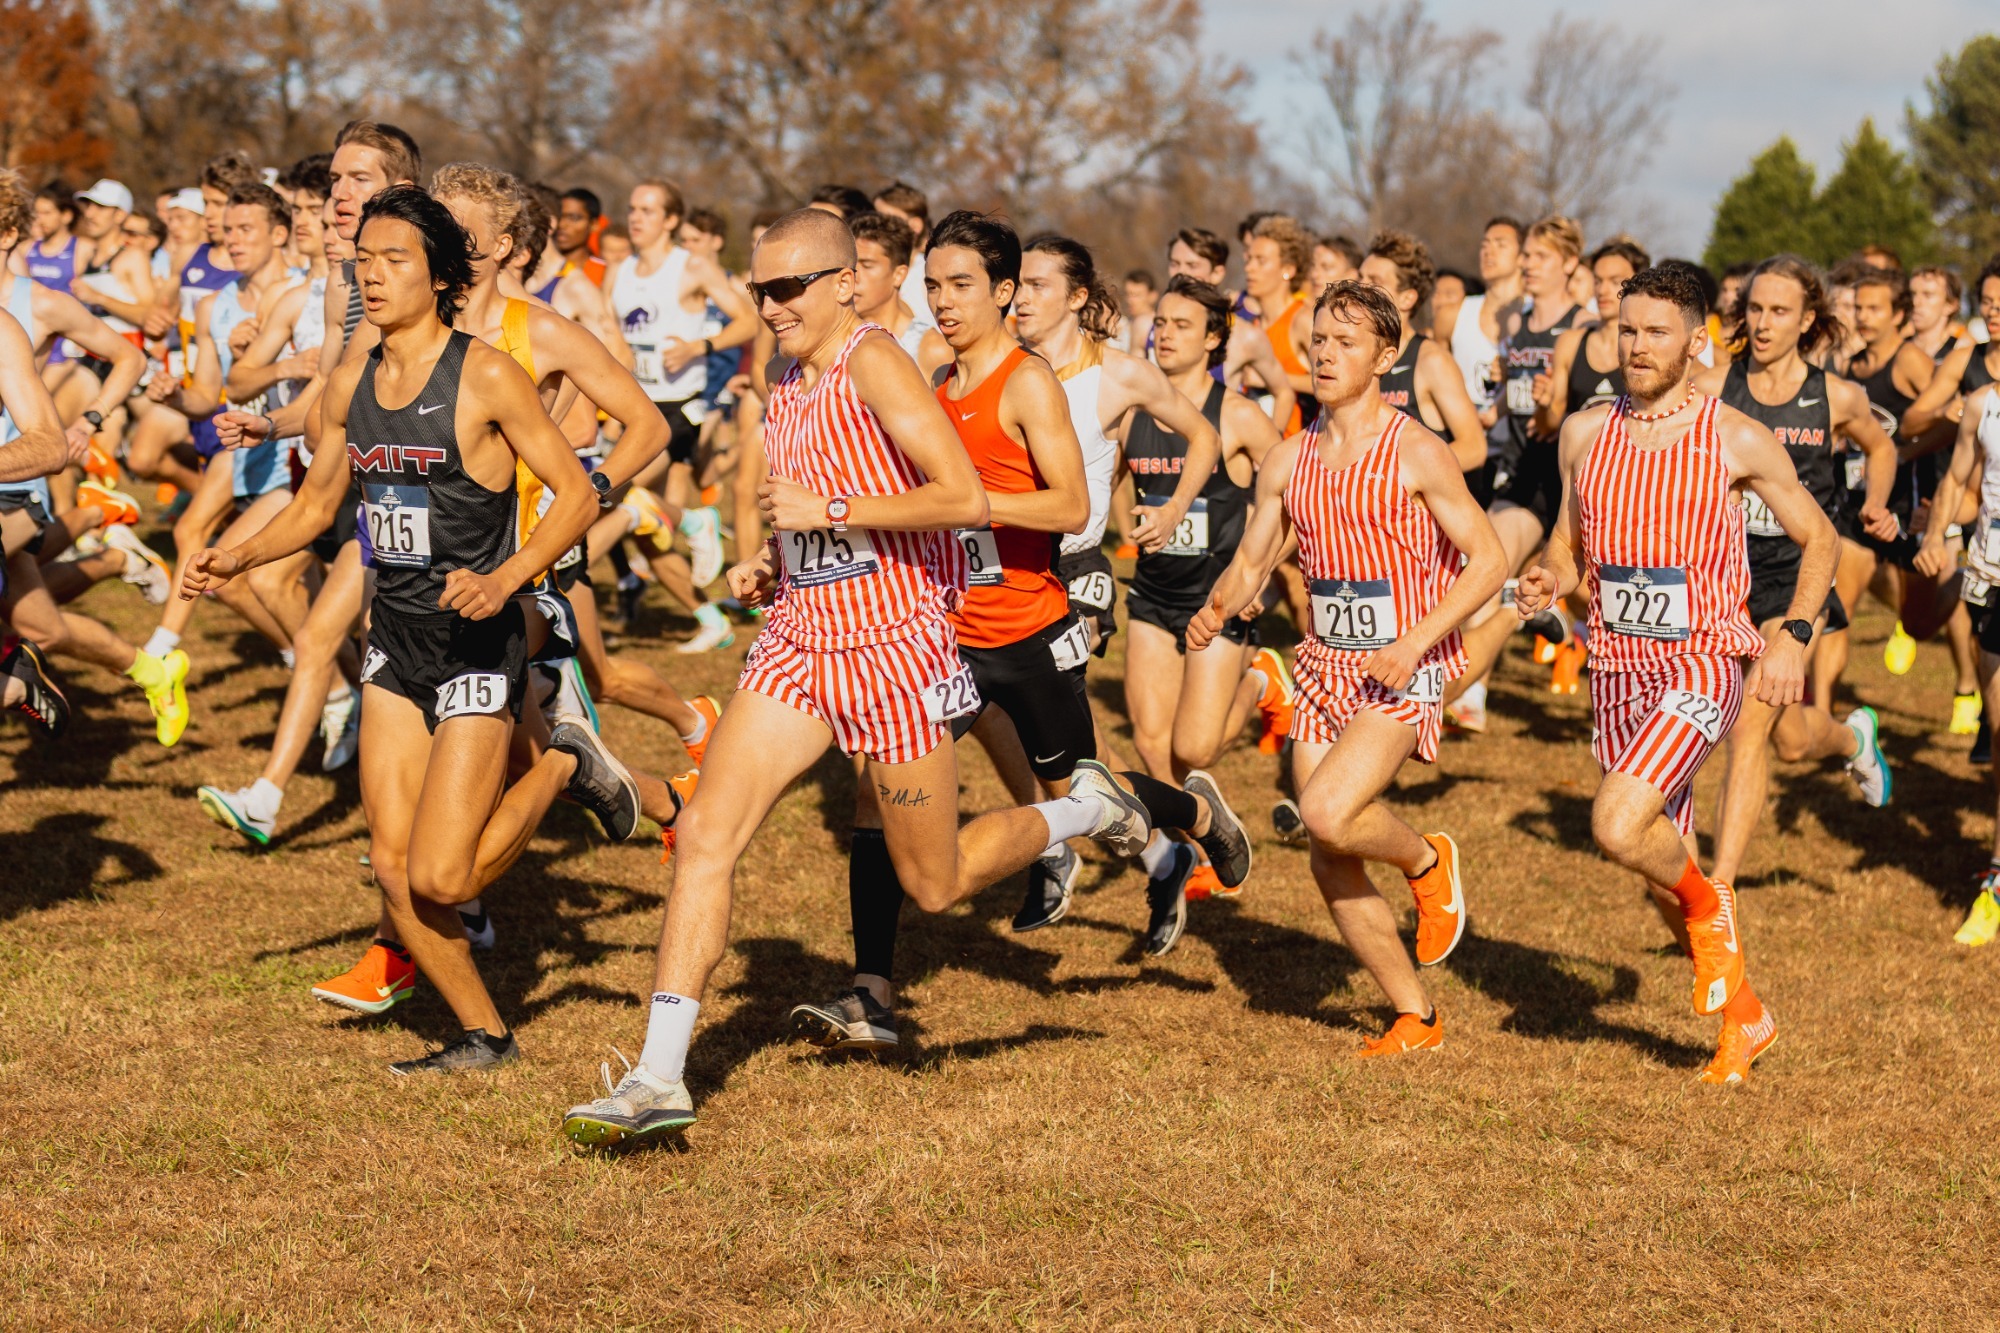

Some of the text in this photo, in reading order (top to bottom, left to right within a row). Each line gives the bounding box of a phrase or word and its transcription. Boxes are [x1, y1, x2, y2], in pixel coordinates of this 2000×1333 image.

[347, 443, 446, 475] MIT
[1128, 457, 1218, 474] WESLE
[1742, 496, 1780, 527] 34
[371, 511, 414, 553] 215
[793, 528, 854, 573] 225
[1068, 573, 1105, 601] 75
[1326, 603, 1377, 639] 219
[1615, 589, 1671, 627] 222
[444, 676, 492, 713] 215
[1406, 667, 1442, 697] 219
[1675, 692, 1720, 736] 222
